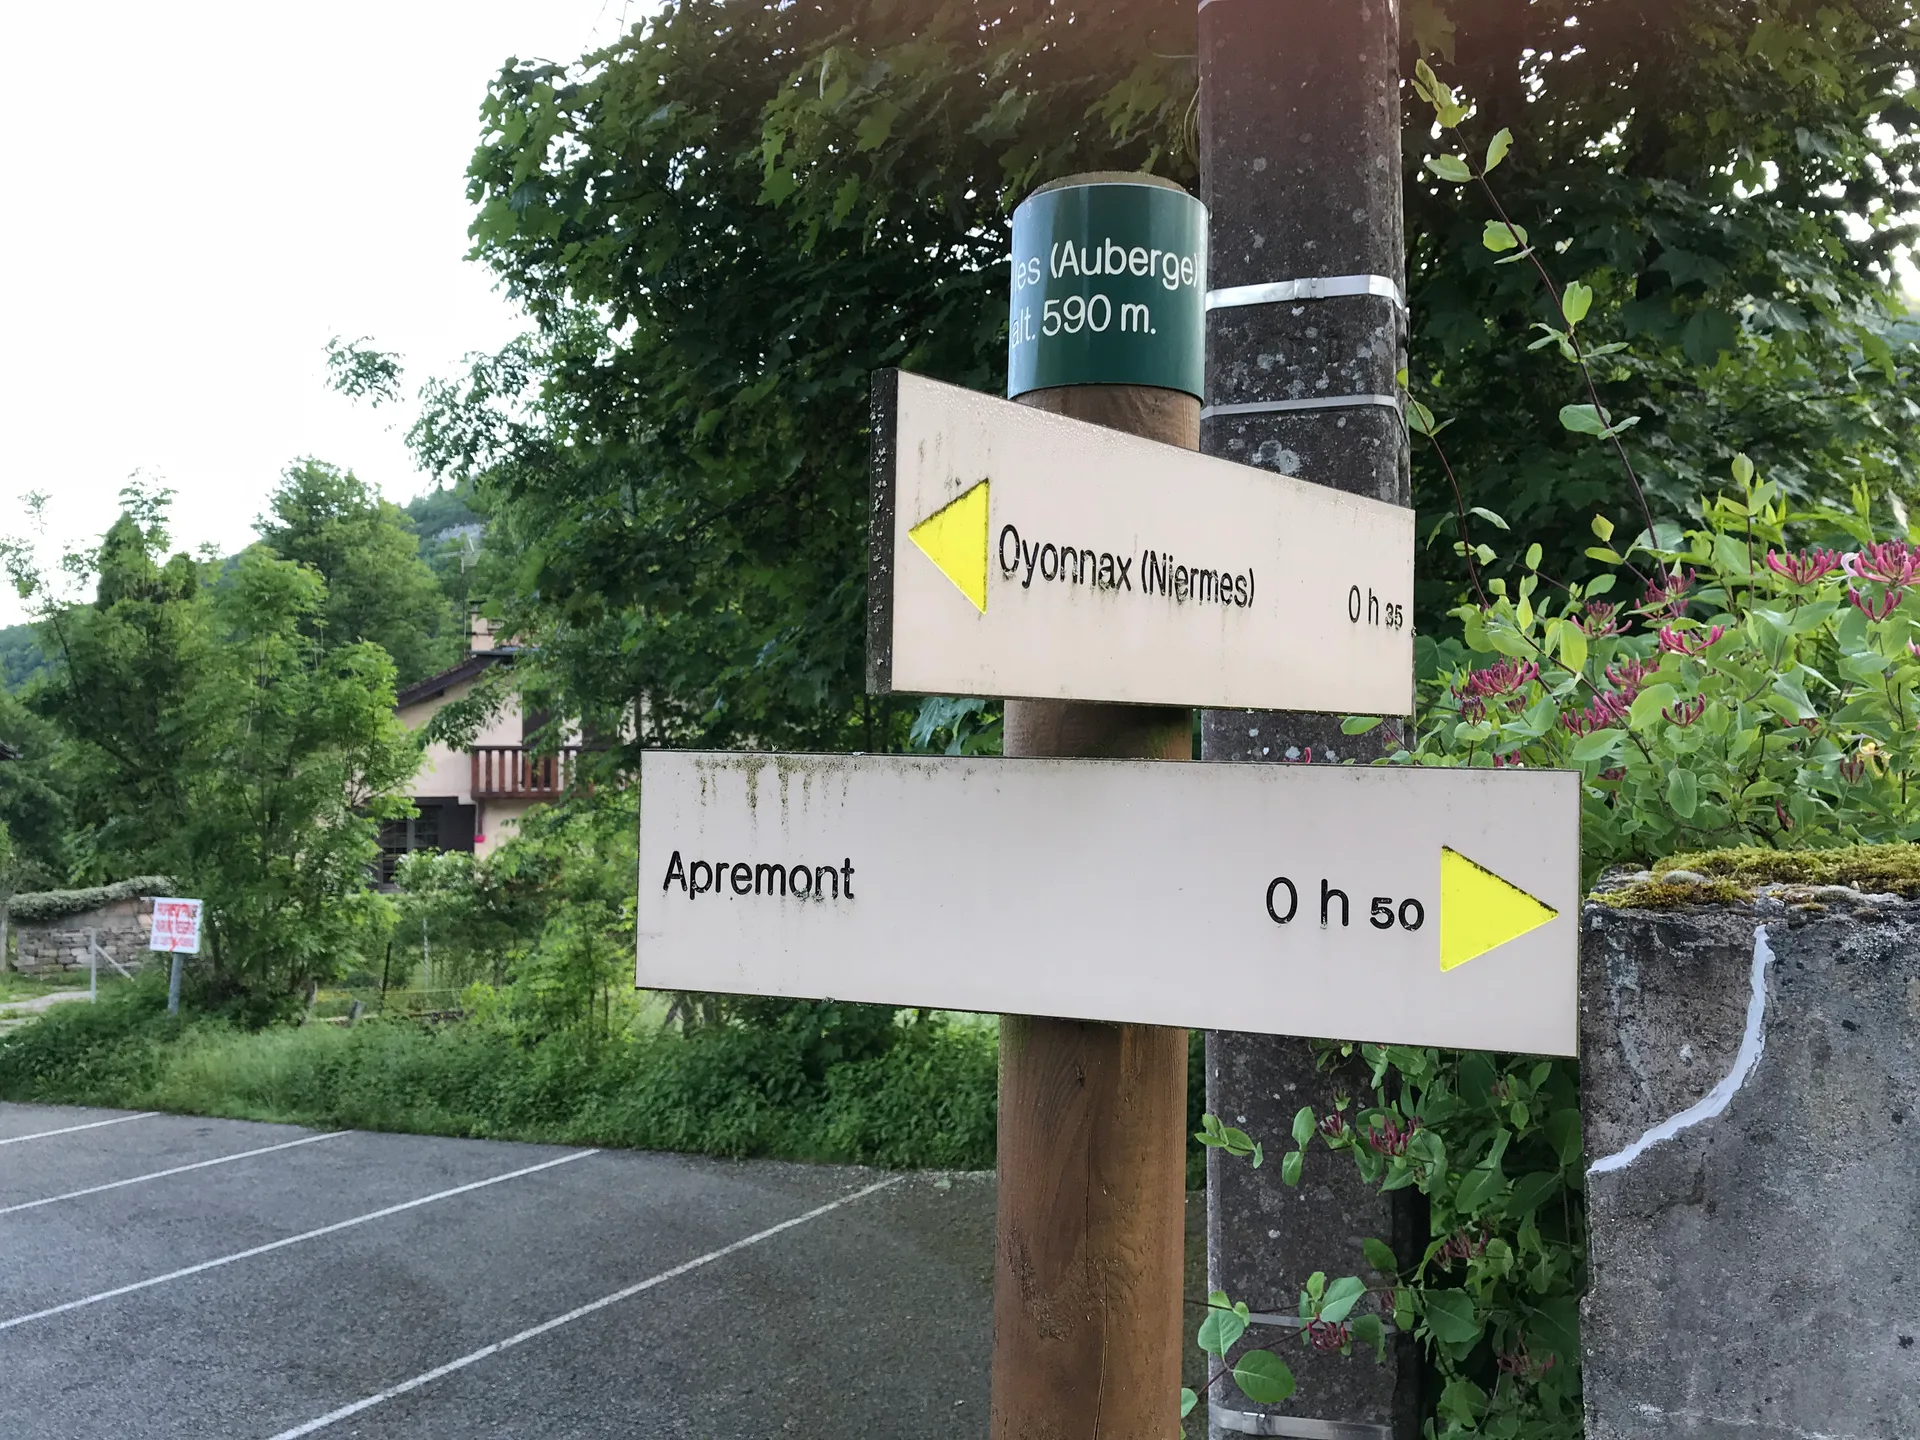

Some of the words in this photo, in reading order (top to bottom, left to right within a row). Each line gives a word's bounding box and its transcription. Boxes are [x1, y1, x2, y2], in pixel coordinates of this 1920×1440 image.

[1050, 237, 1198, 291] (Auberge)
[1011, 306, 1036, 349] alt.
[1042, 294, 1112, 337] 590
[1120, 302, 1157, 335] m.
[999, 524, 1132, 592] Oyonnax
[1140, 549, 1255, 608] (Niermes)
[1368, 587, 1379, 626] h
[1385, 602, 1403, 631] 35
[662, 850, 855, 901] Apremont
[1320, 878, 1349, 929] h
[1369, 896, 1425, 932] 50
